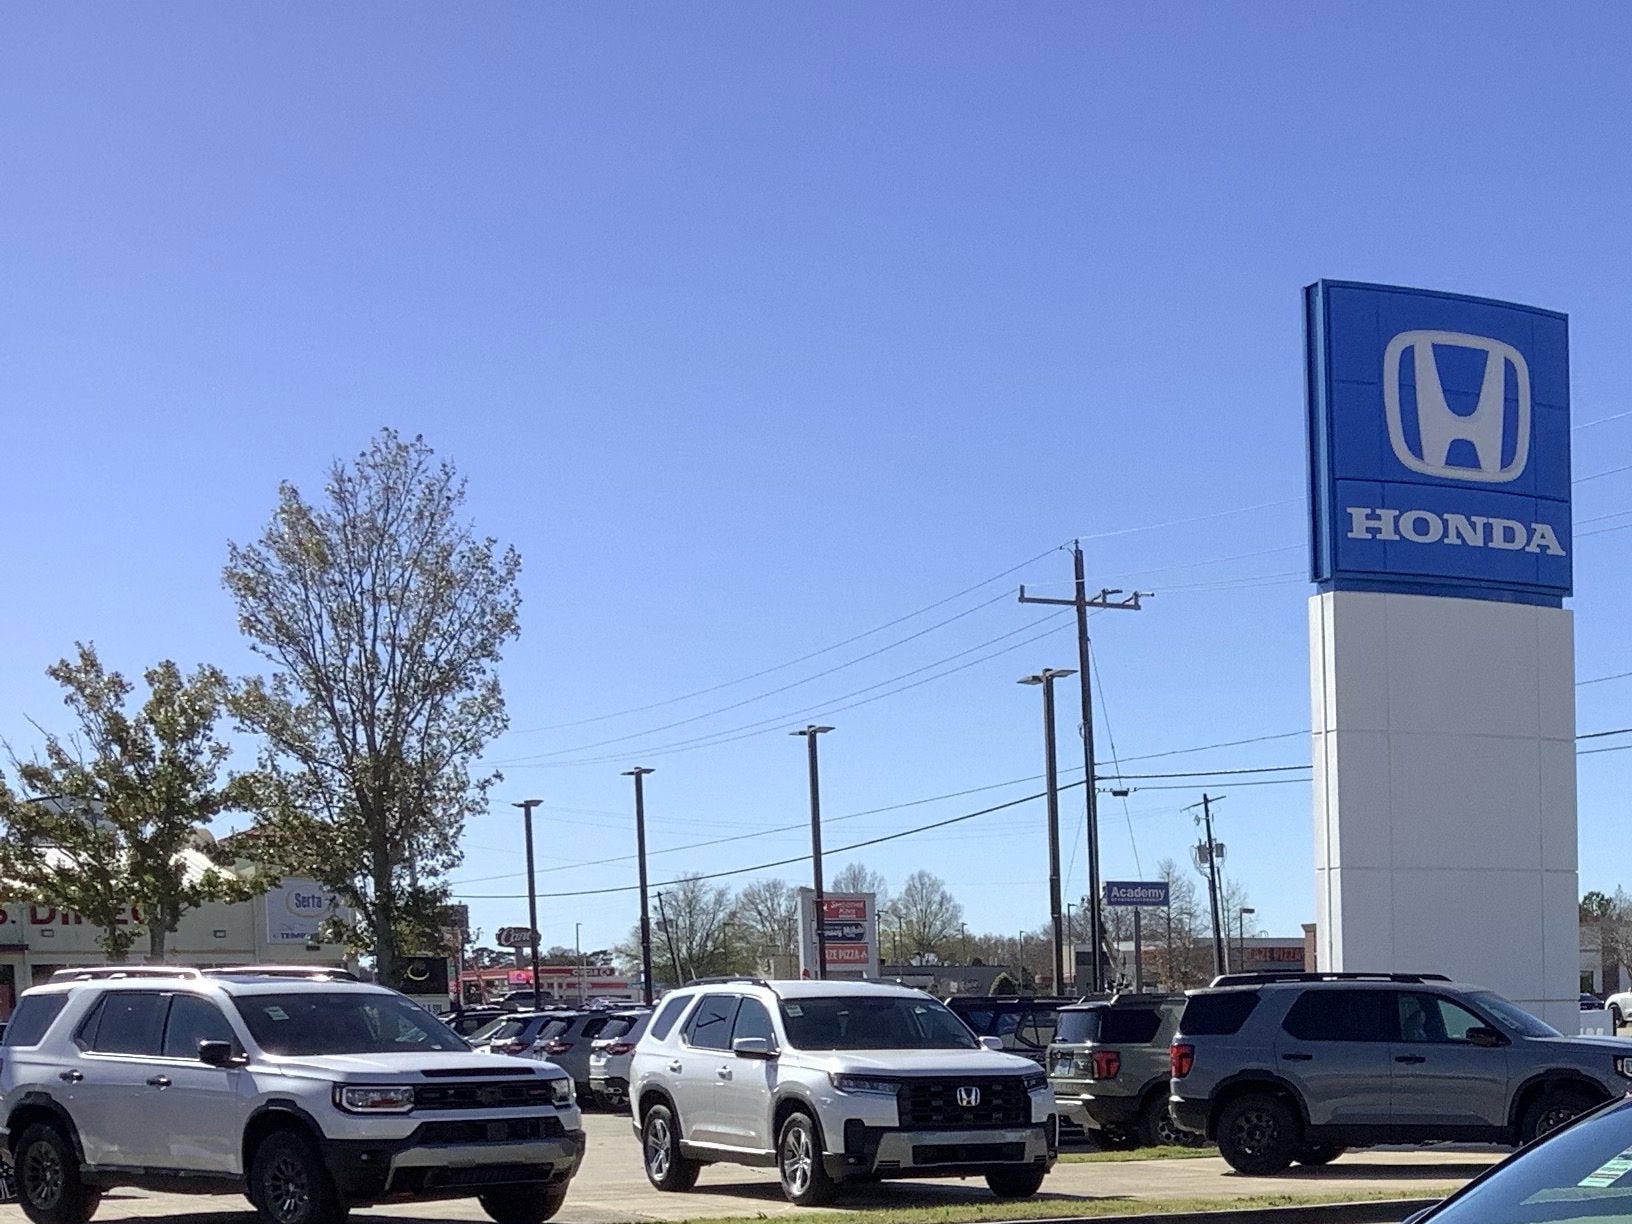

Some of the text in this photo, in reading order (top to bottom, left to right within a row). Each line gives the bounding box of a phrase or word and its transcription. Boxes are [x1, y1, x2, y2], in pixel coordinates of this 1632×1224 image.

[1346, 507, 1566, 556] HONDA
[294, 892, 322, 908] Serta
[1110, 886, 1166, 901] Academy
[839, 949, 859, 960] PIZZA
